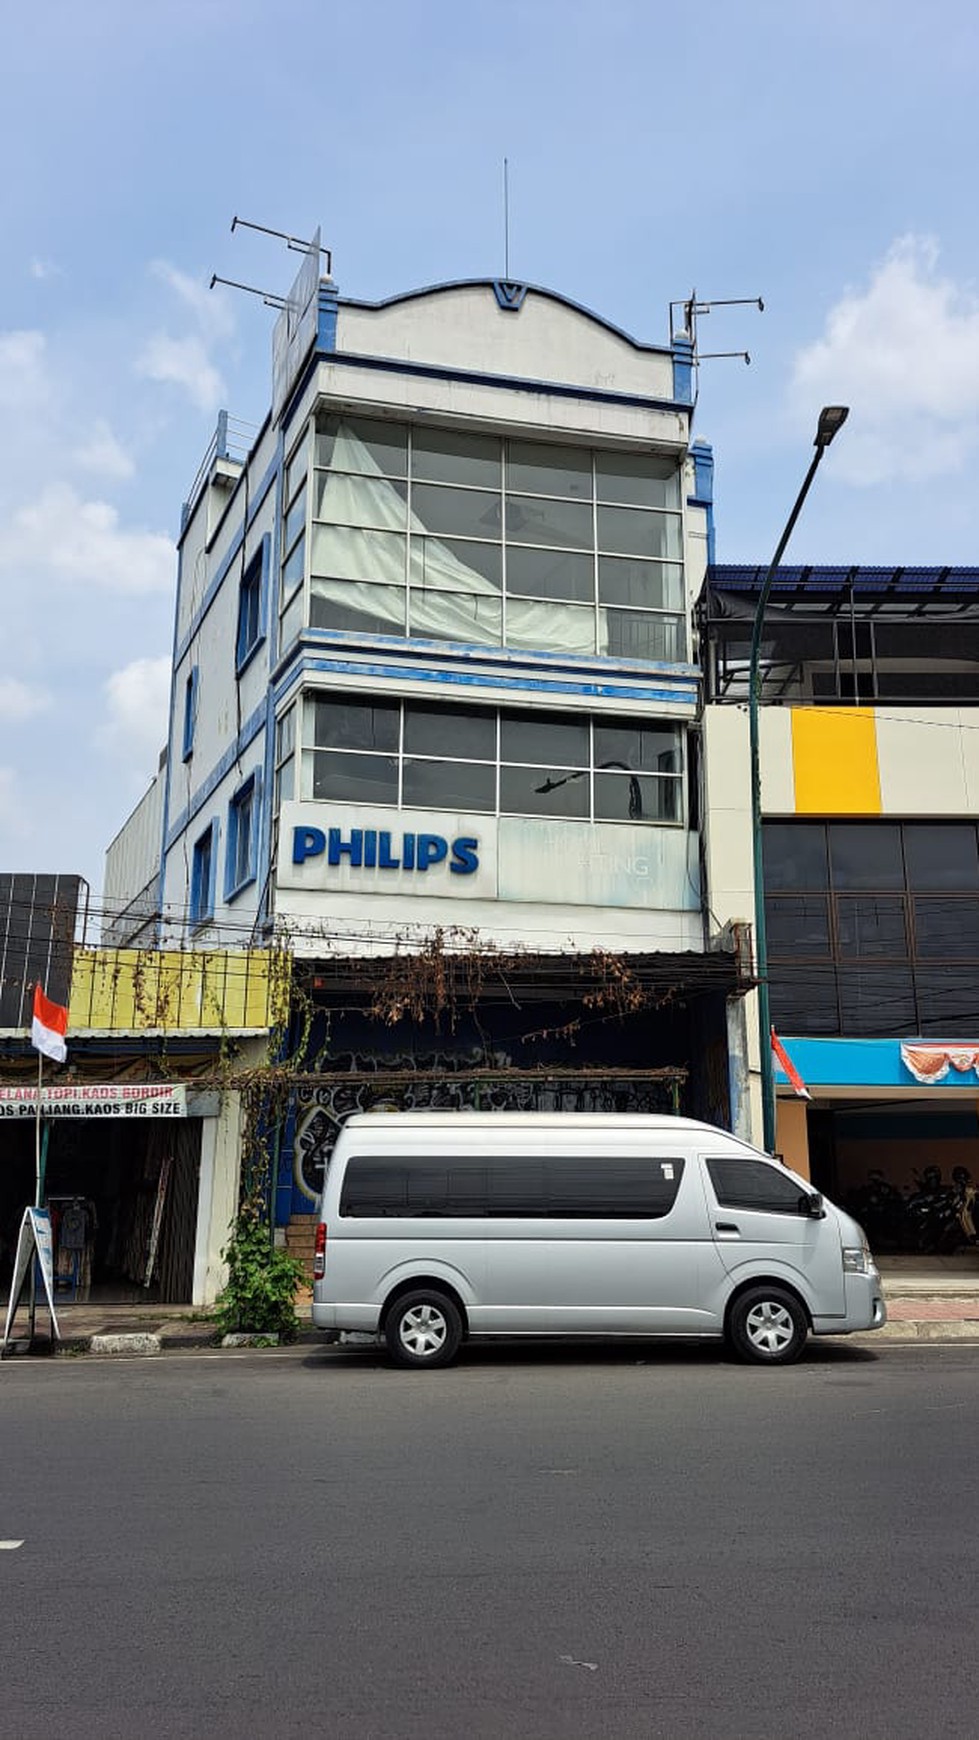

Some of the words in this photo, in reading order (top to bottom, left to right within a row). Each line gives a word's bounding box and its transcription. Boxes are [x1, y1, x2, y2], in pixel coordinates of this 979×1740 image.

[292, 826, 479, 875] PHILIPS
[125, 1102, 147, 1114] BIG
[152, 1102, 181, 1115] SIZE
